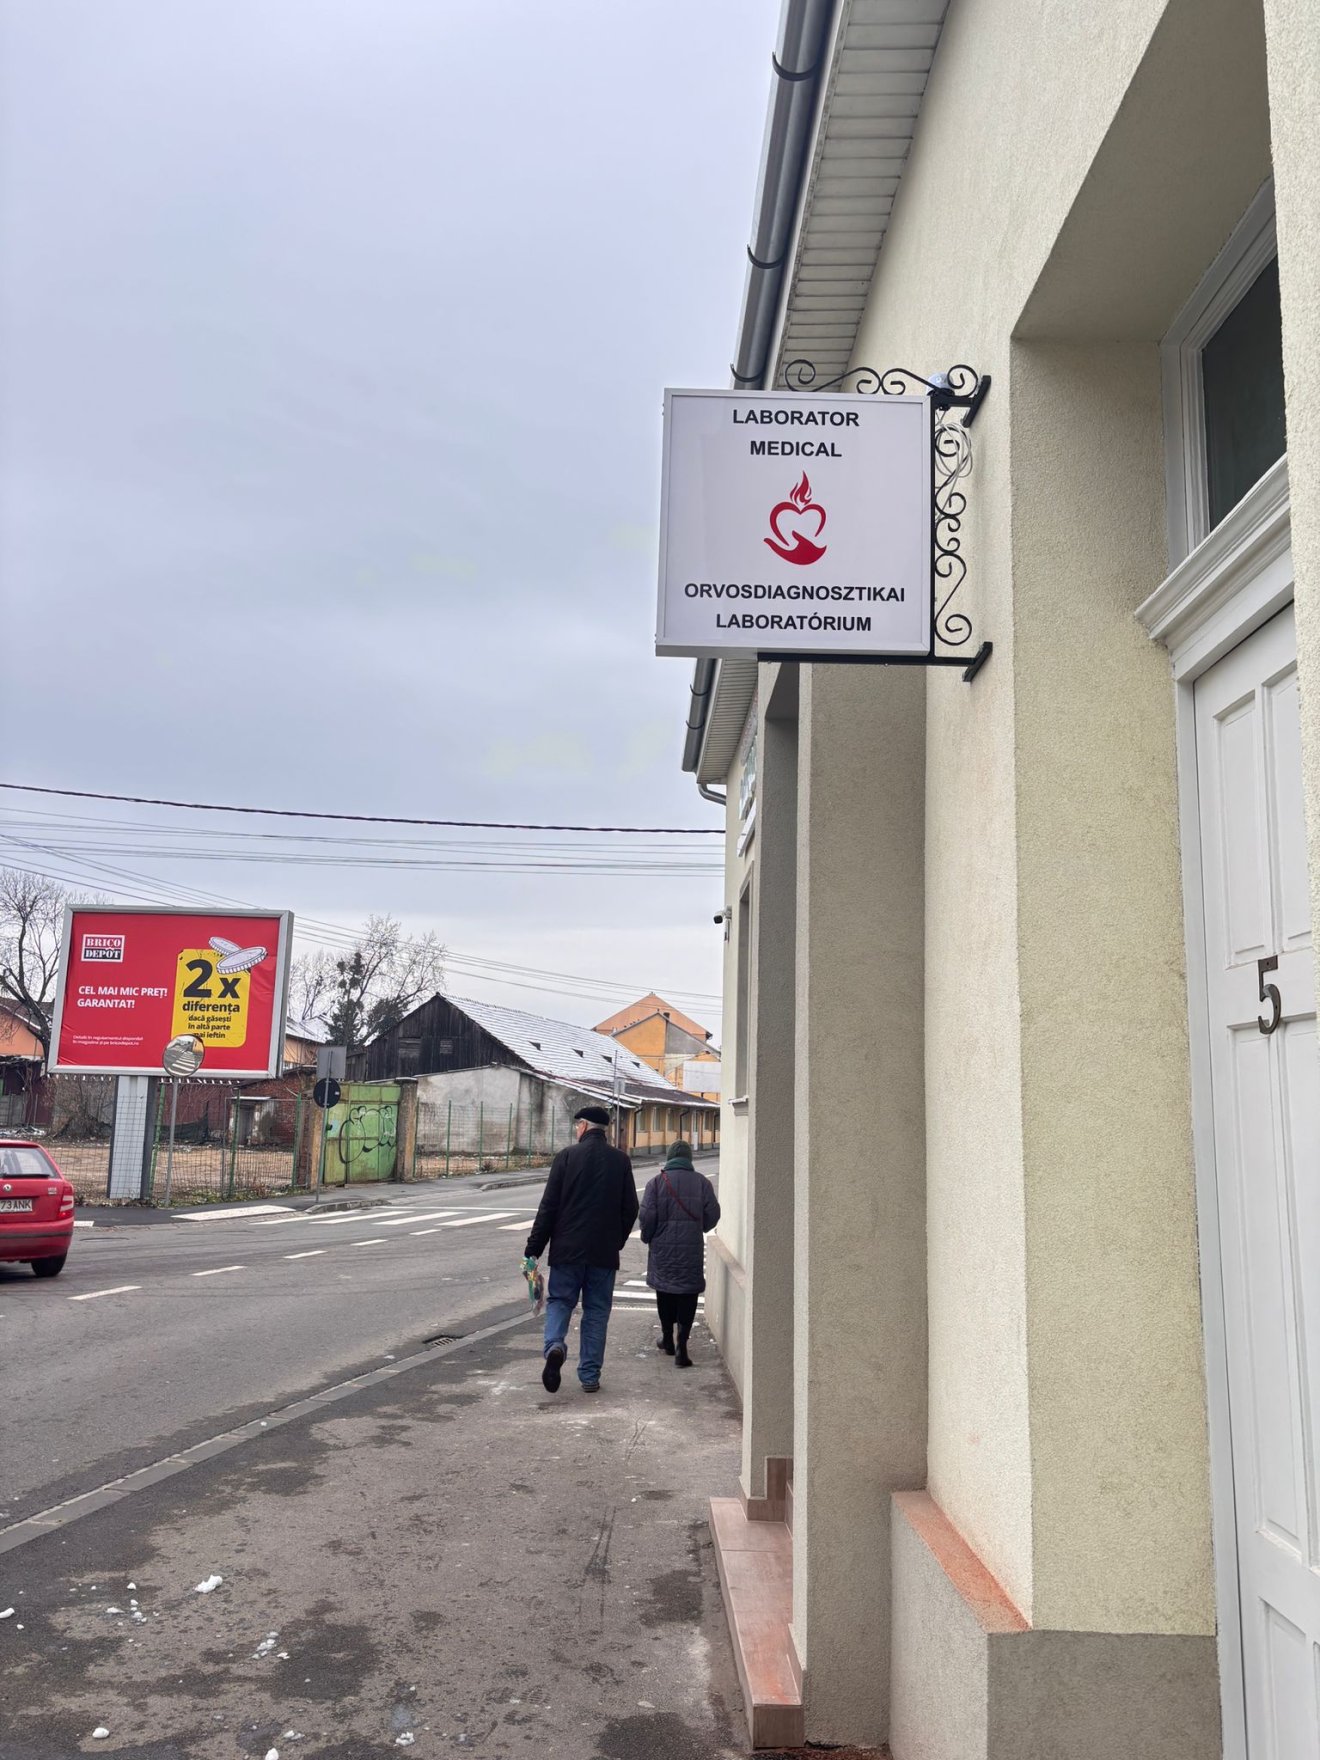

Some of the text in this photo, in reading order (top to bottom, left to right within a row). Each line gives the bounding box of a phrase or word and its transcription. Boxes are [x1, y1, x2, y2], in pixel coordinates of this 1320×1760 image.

[733, 409, 860, 427] LABORATOR
[750, 440, 842, 457] MEDICAL
[684, 583, 905, 602] ORVOSDIAGNOSZTIKAI
[716, 612, 872, 631] LABORATÓRIUM
[86, 938, 121, 947] BRICO
[78, 986, 96, 995] CEL
[98, 986, 118, 995] MAI
[120, 987, 139, 996] MIC
[1257, 955, 1282, 1035] 5
[77, 998, 135, 1009] GARANTAT!
[188, 1014, 205, 1022] dacă
[211, 1024, 231, 1032] parte
[206, 1031, 226, 1039] ieftin
